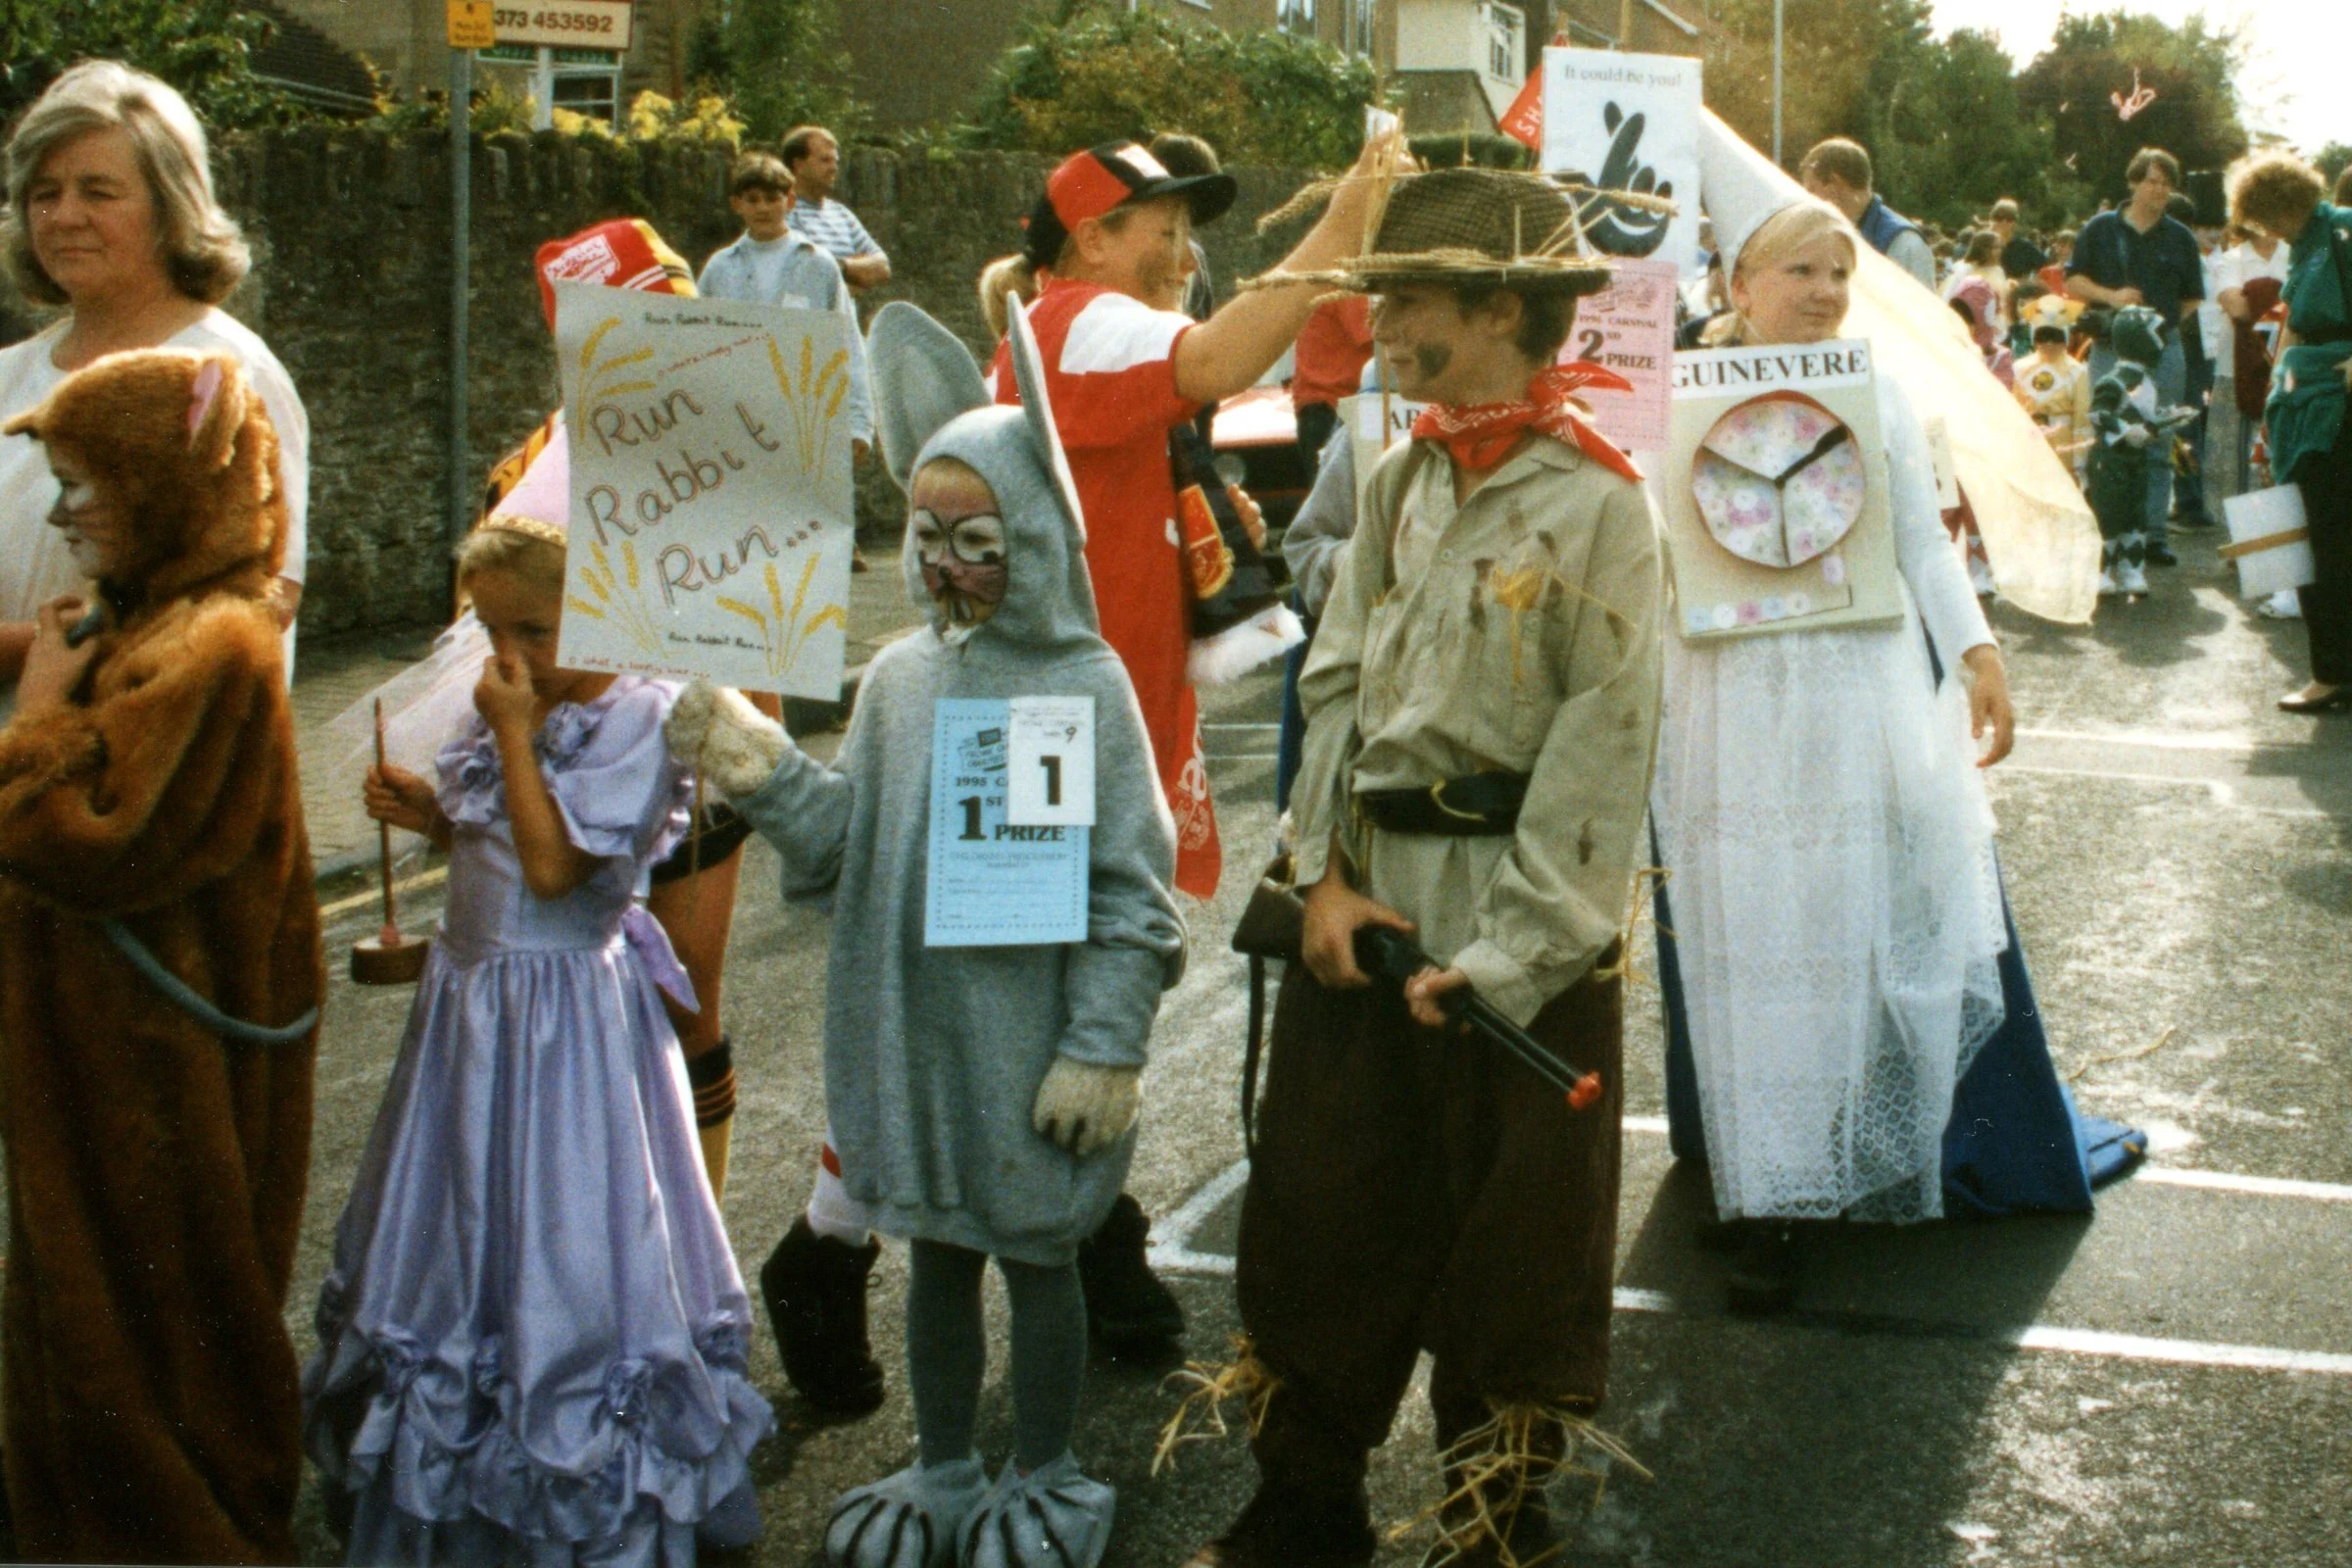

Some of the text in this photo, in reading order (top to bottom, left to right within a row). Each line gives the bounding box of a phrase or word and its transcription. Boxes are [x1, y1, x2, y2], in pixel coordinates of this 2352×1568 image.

[495, 10, 613, 33] 373 453592
[1580, 67, 1623, 82] could
[1578, 328, 1604, 365] 2
[1606, 353, 1657, 369] PRIZE
[1671, 349, 1867, 389] GUINEVERE
[589, 389, 704, 457] Run
[584, 402, 780, 547] Rabbit
[1065, 726, 1078, 743] 9
[956, 776, 987, 787] 1995
[1040, 755, 1061, 807] 1
[957, 795, 1066, 842] 1 ST PRIZE
